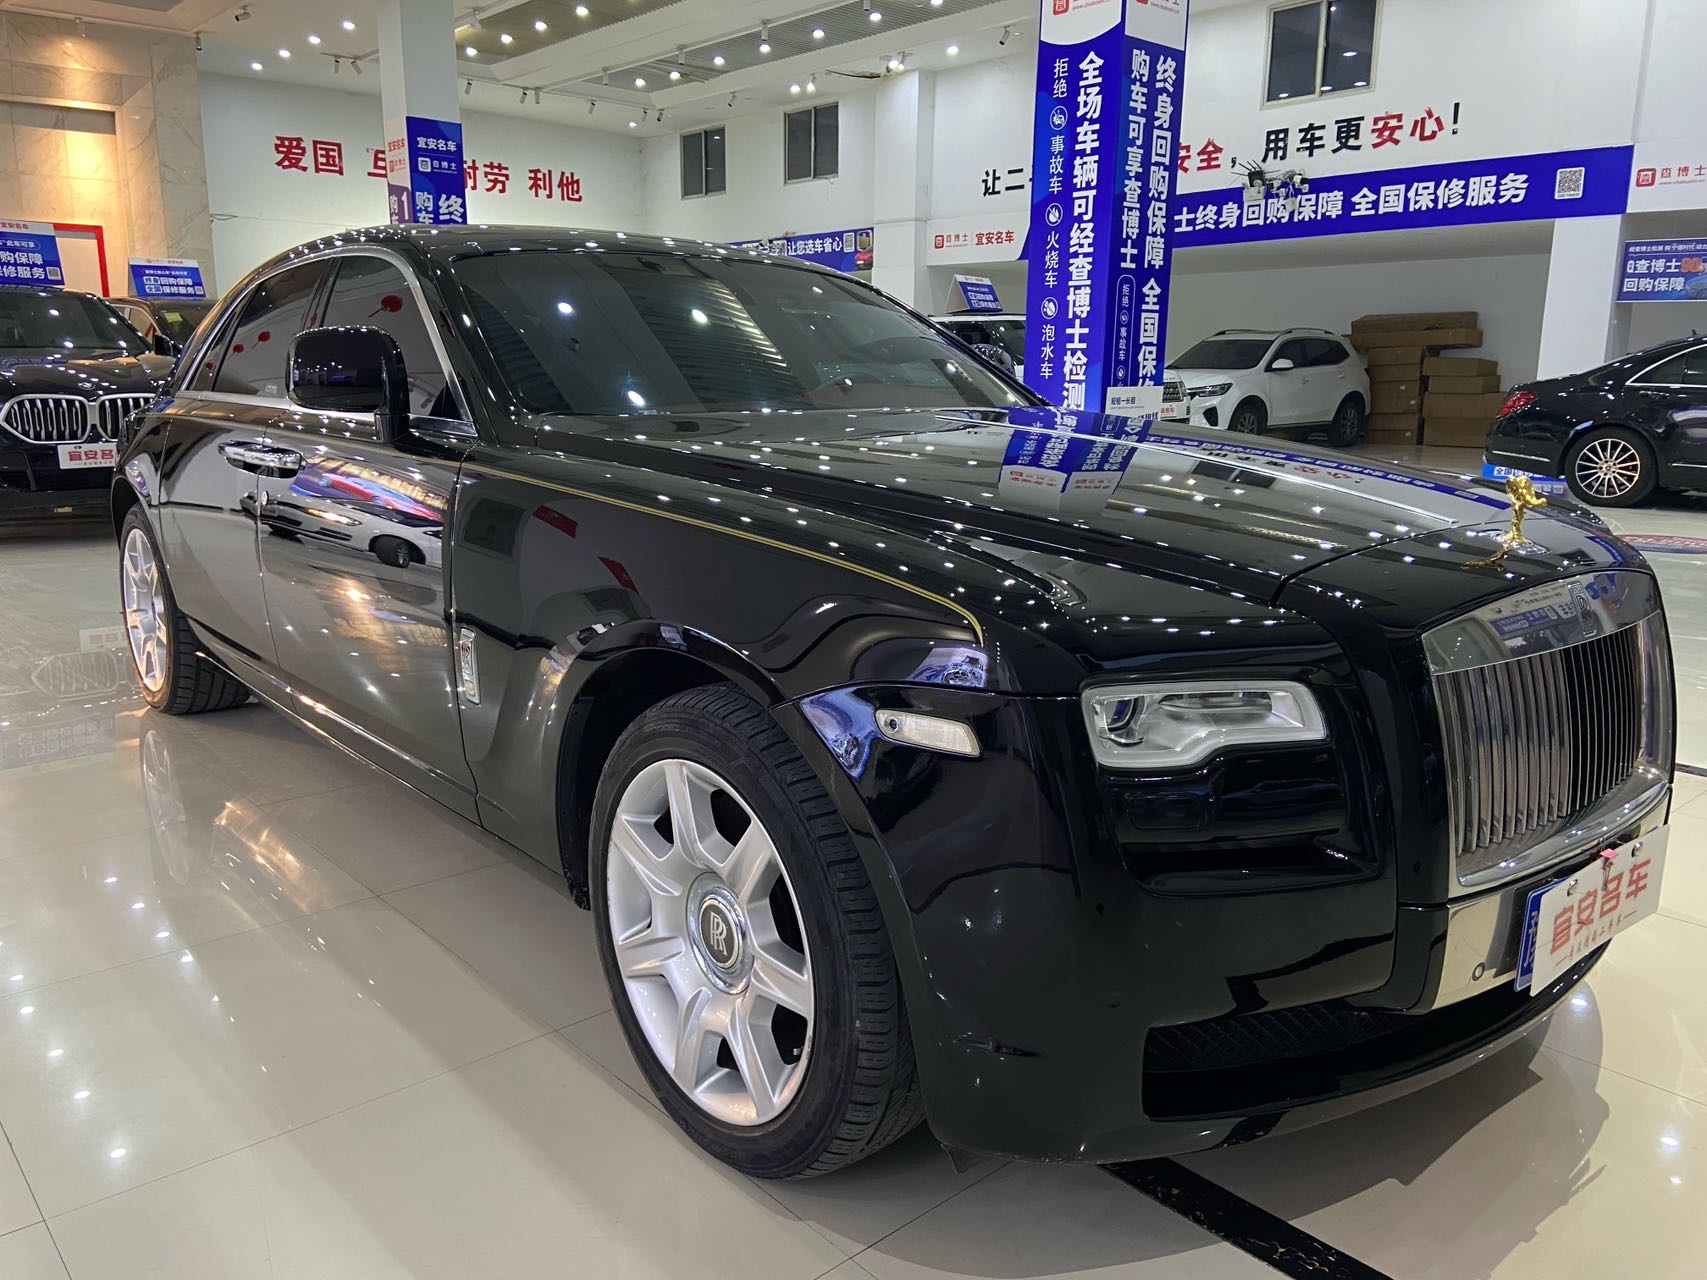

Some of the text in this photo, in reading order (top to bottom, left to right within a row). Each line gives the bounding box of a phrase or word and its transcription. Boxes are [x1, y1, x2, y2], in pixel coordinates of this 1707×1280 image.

[1053, 58, 1069, 98] 拒绝
[274, 136, 344, 176] 爱国
[416, 136, 457, 152] 宜安名车
[1120, 49, 1150, 269] 购车可享查博士
[1144, 55, 1177, 270] 终身回购保障
[982, 168, 1032, 197] 让二
[1048, 135, 1065, 194] 事故车
[1660, 165, 1707, 179] 查博士
[528, 168, 583, 203] 利他
[1350, 173, 1530, 217] 全国保修服务
[787, 237, 842, 255] 让您选车省心
[975, 229, 1015, 246] 宜安名车
[1062, 51, 1105, 411] 全场车辆可经查博士检测
[0, 265, 45, 279] 修服务
[1044, 231, 1060, 288] 火烧车
[1623, 277, 1685, 292] 回购保障
[1040, 324, 1056, 379] 泡水车
[1550, 858, 1652, 954] 宜安名车
